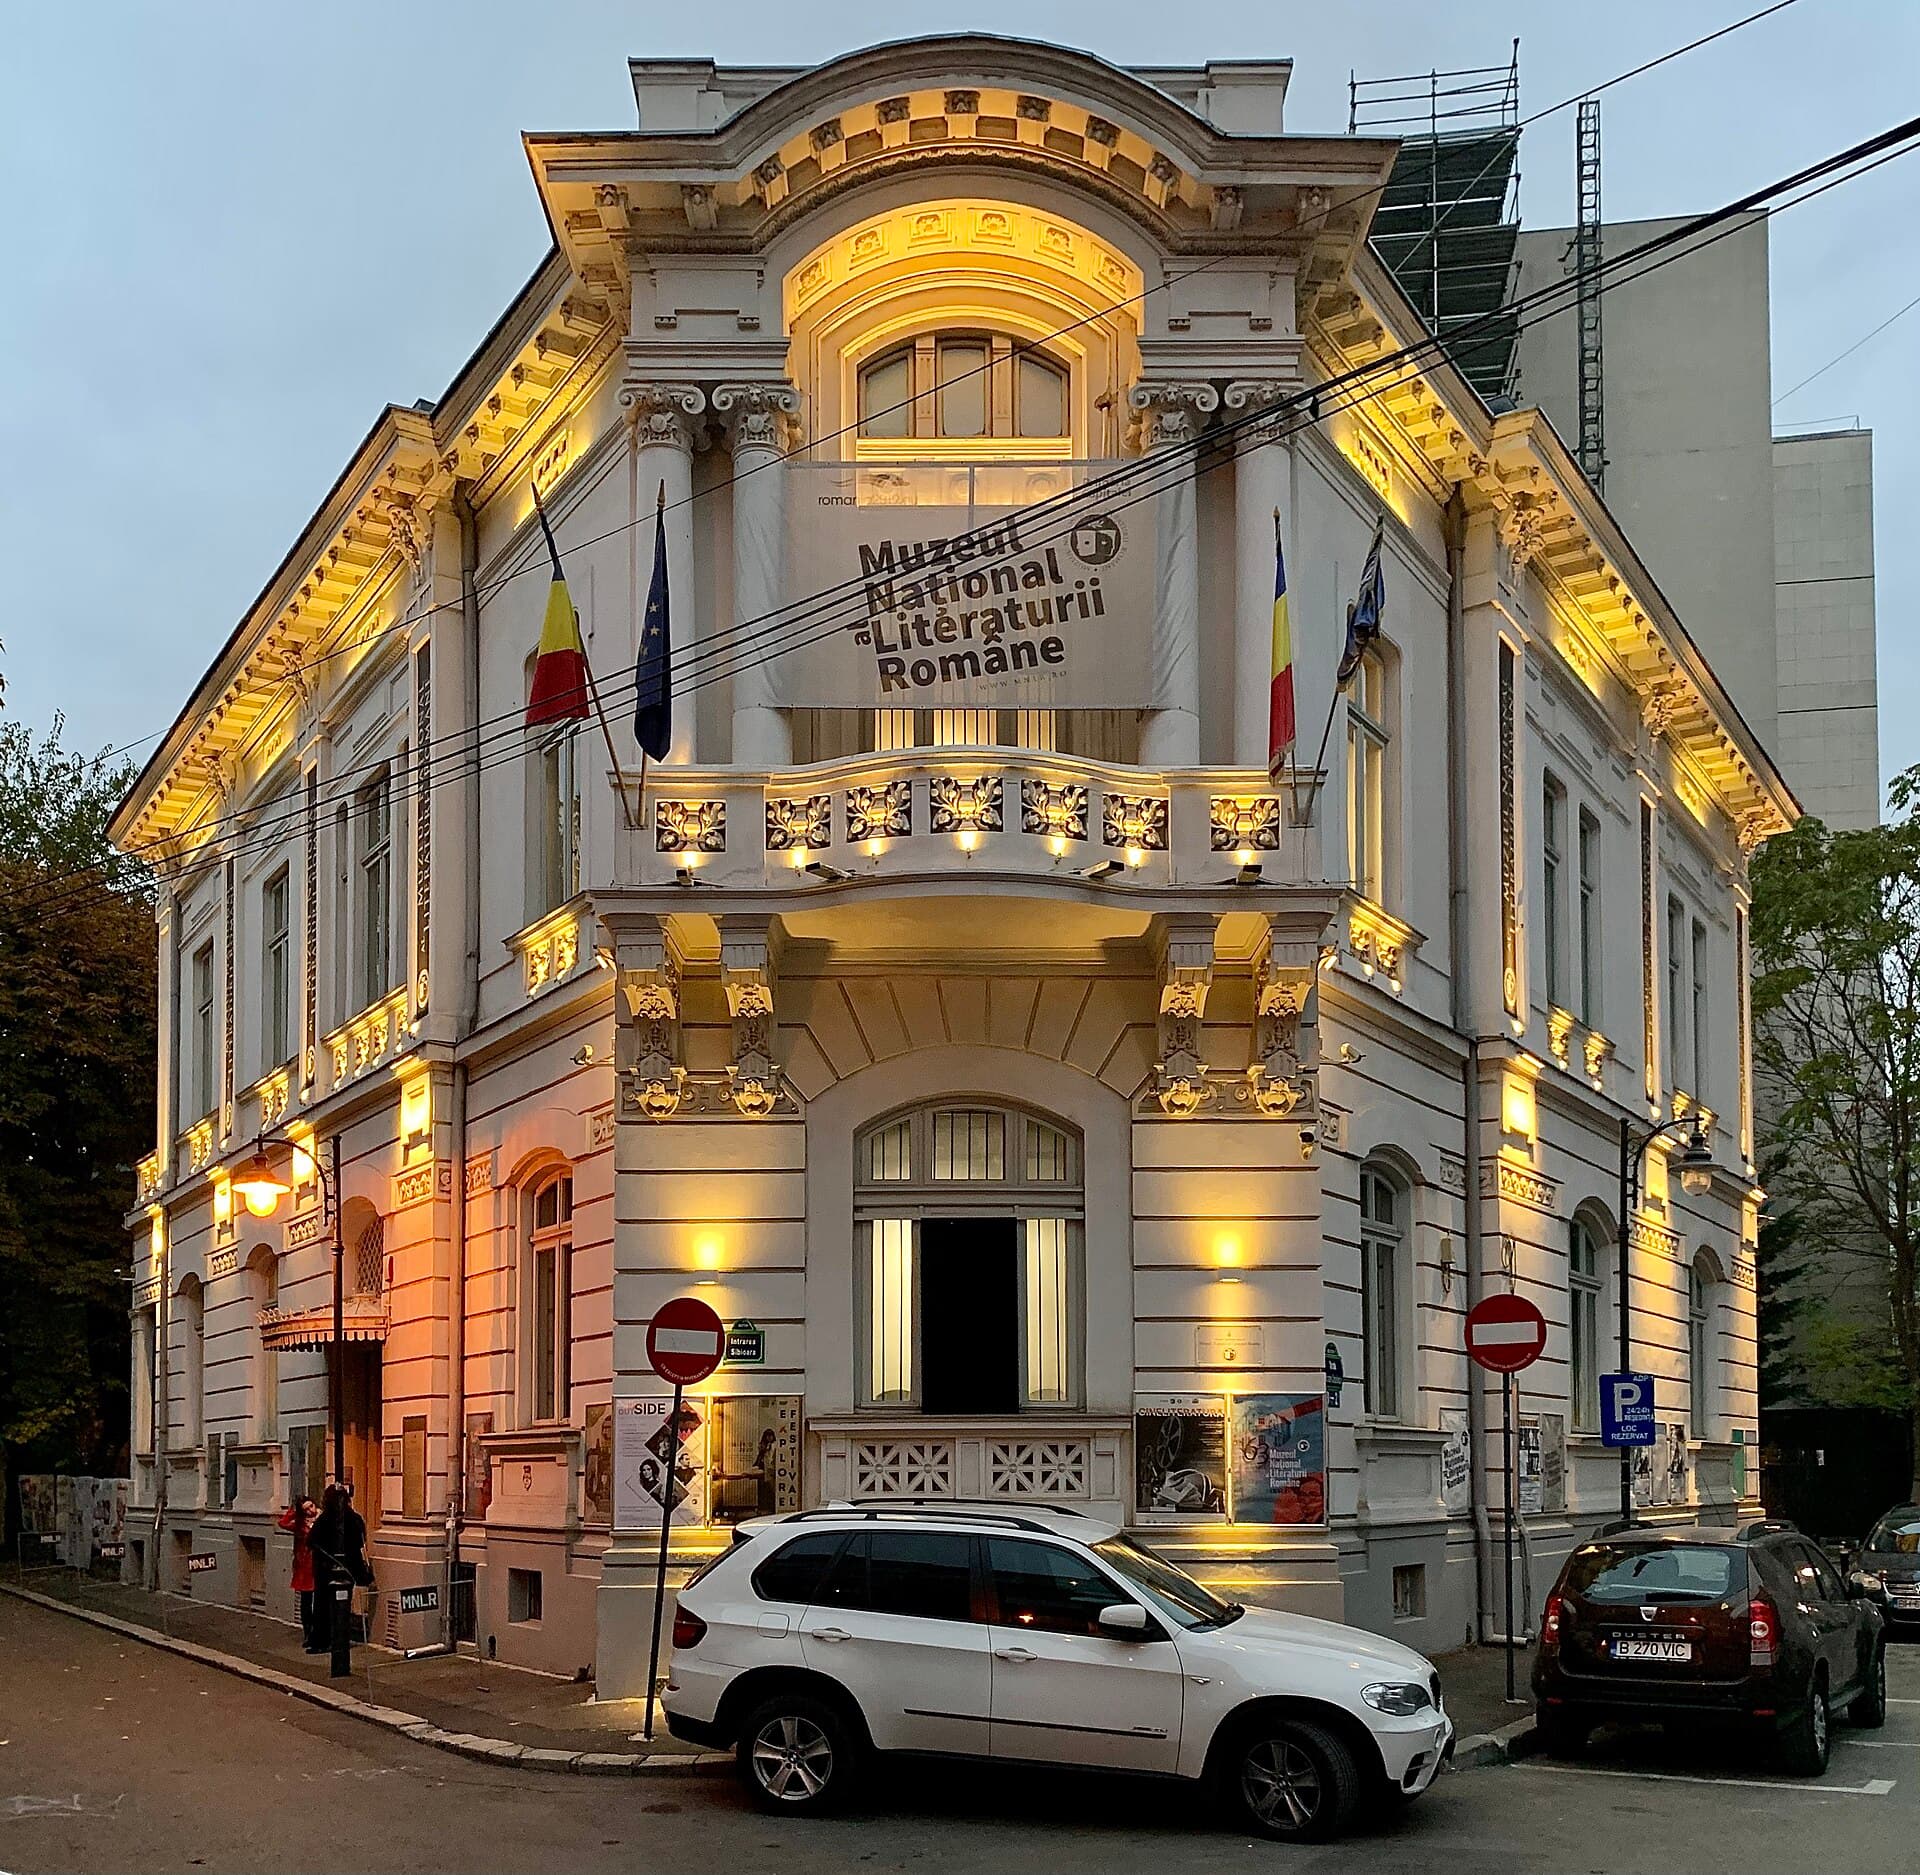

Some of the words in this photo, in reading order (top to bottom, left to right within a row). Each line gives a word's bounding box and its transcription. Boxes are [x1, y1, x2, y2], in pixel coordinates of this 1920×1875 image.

[858, 517, 1023, 577] Muzeul
[872, 577, 1105, 655] Literaturii
[878, 631, 1065, 693] Române
[1614, 1383, 1641, 1422] P
[1611, 1432, 1649, 1440] REZERVAT
[788, 1409, 797, 1507] FESTIVAL
[188, 1557, 217, 1570] MNLR
[402, 1592, 437, 1610] MNLR
[1612, 1631, 1686, 1640] DUSTER
[1619, 1641, 1630, 1655] B
[1633, 1642, 1659, 1656] 270
[1661, 1643, 1686, 1657] VIC
